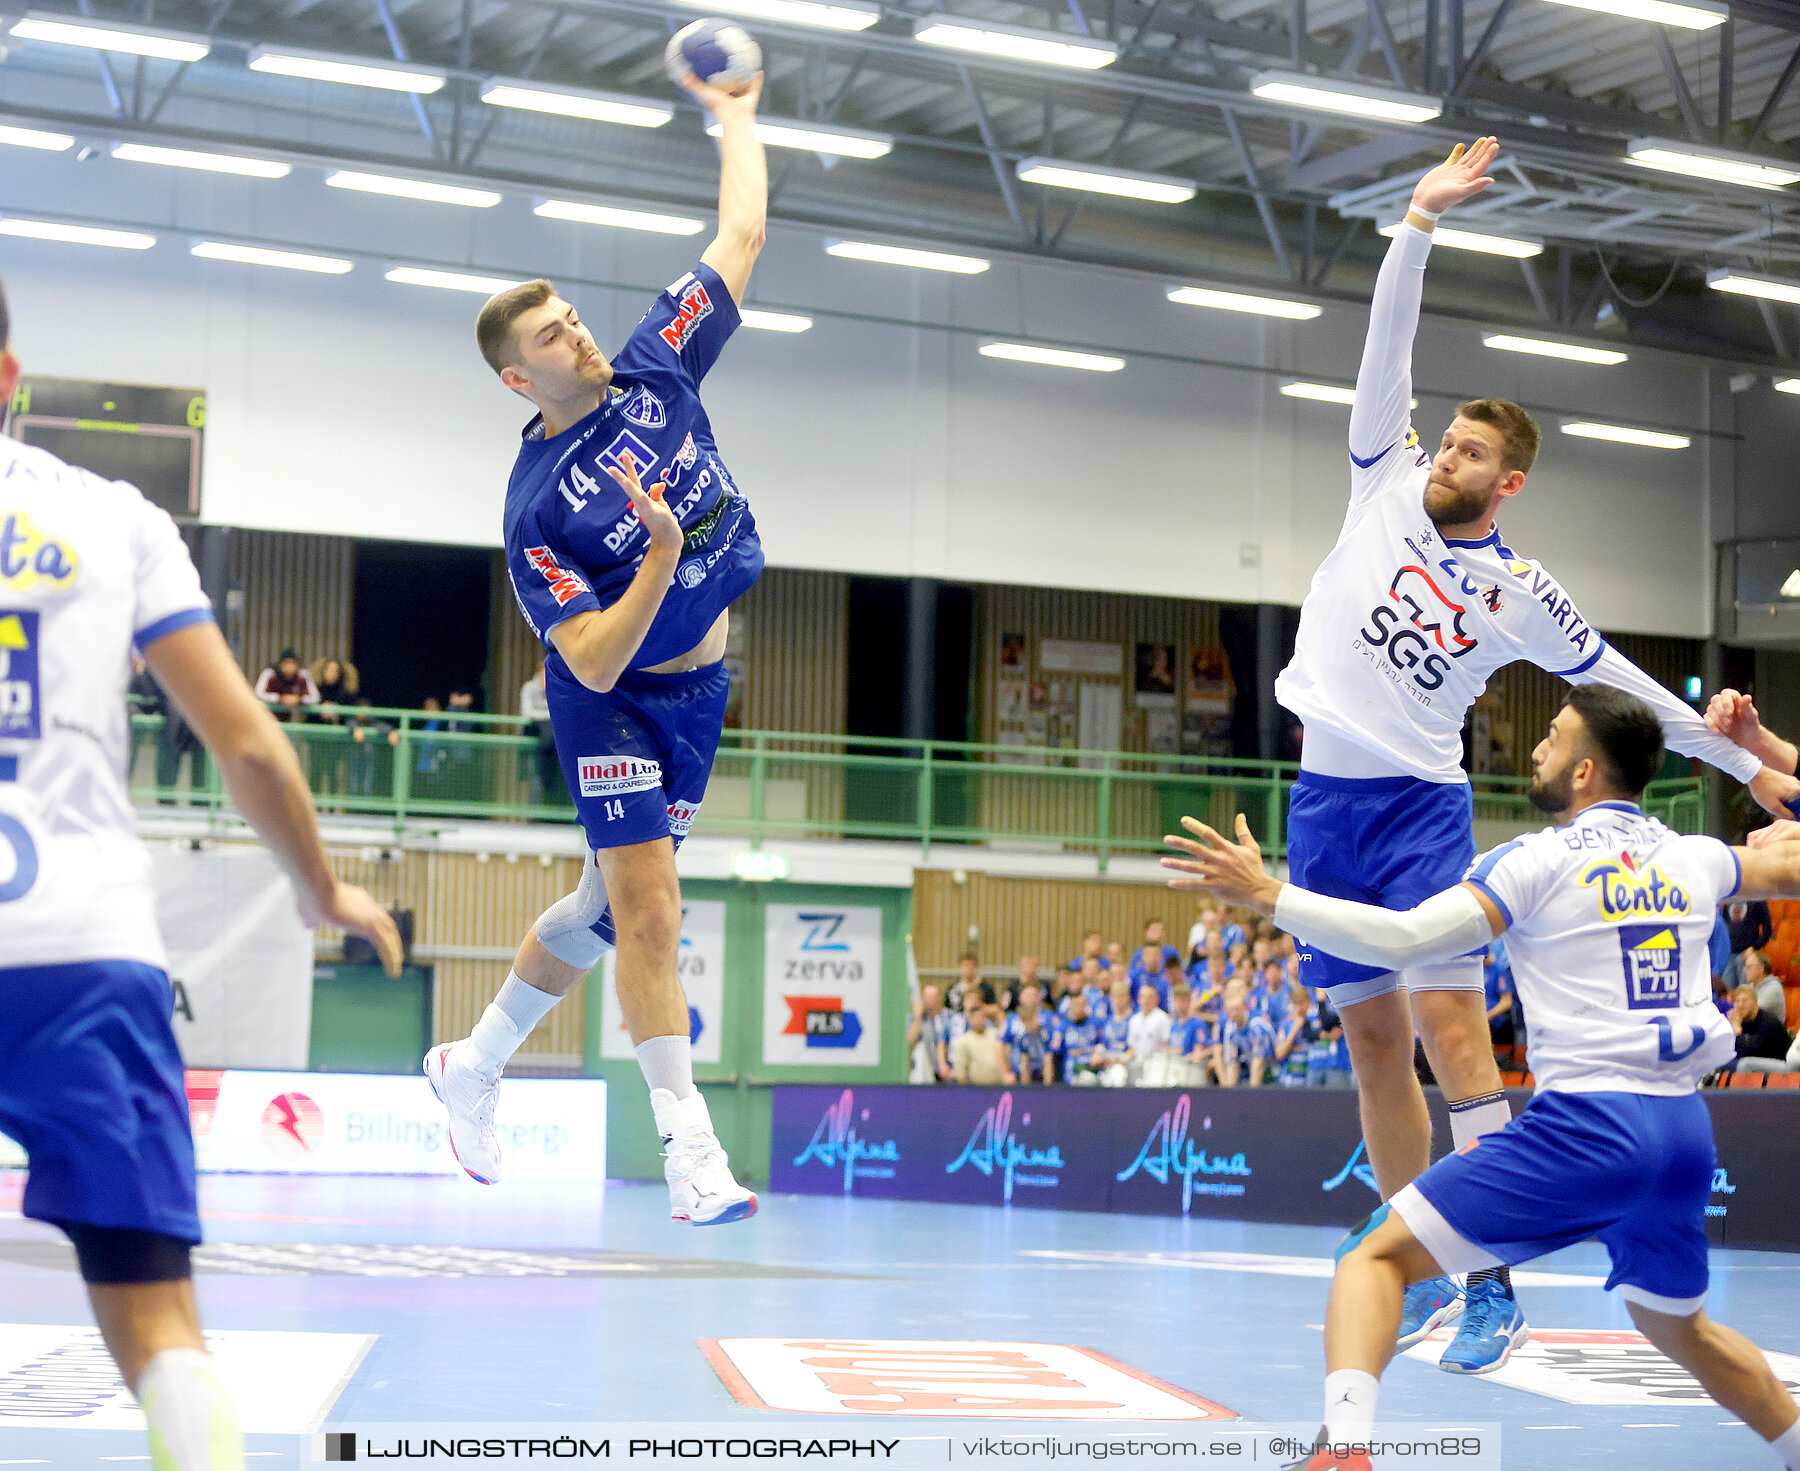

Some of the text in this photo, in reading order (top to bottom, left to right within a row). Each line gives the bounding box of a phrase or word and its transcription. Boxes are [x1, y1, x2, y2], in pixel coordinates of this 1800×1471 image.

[660, 287, 710, 349] MAXI
[558, 462, 602, 513] 14
[670, 468, 712, 521] LVO
[1532, 570, 1590, 654] VARTA
[1360, 605, 1452, 691] SGS
[603, 799, 626, 821] 14
[1585, 864, 1688, 914] Tenta
[784, 957, 865, 981] zerva
[806, 1010, 843, 1035] PLS
[345, 1111, 568, 1154] Billing nergi
[946, 1091, 1064, 1201] Alpina
[1116, 1094, 1253, 1213] Alpina
